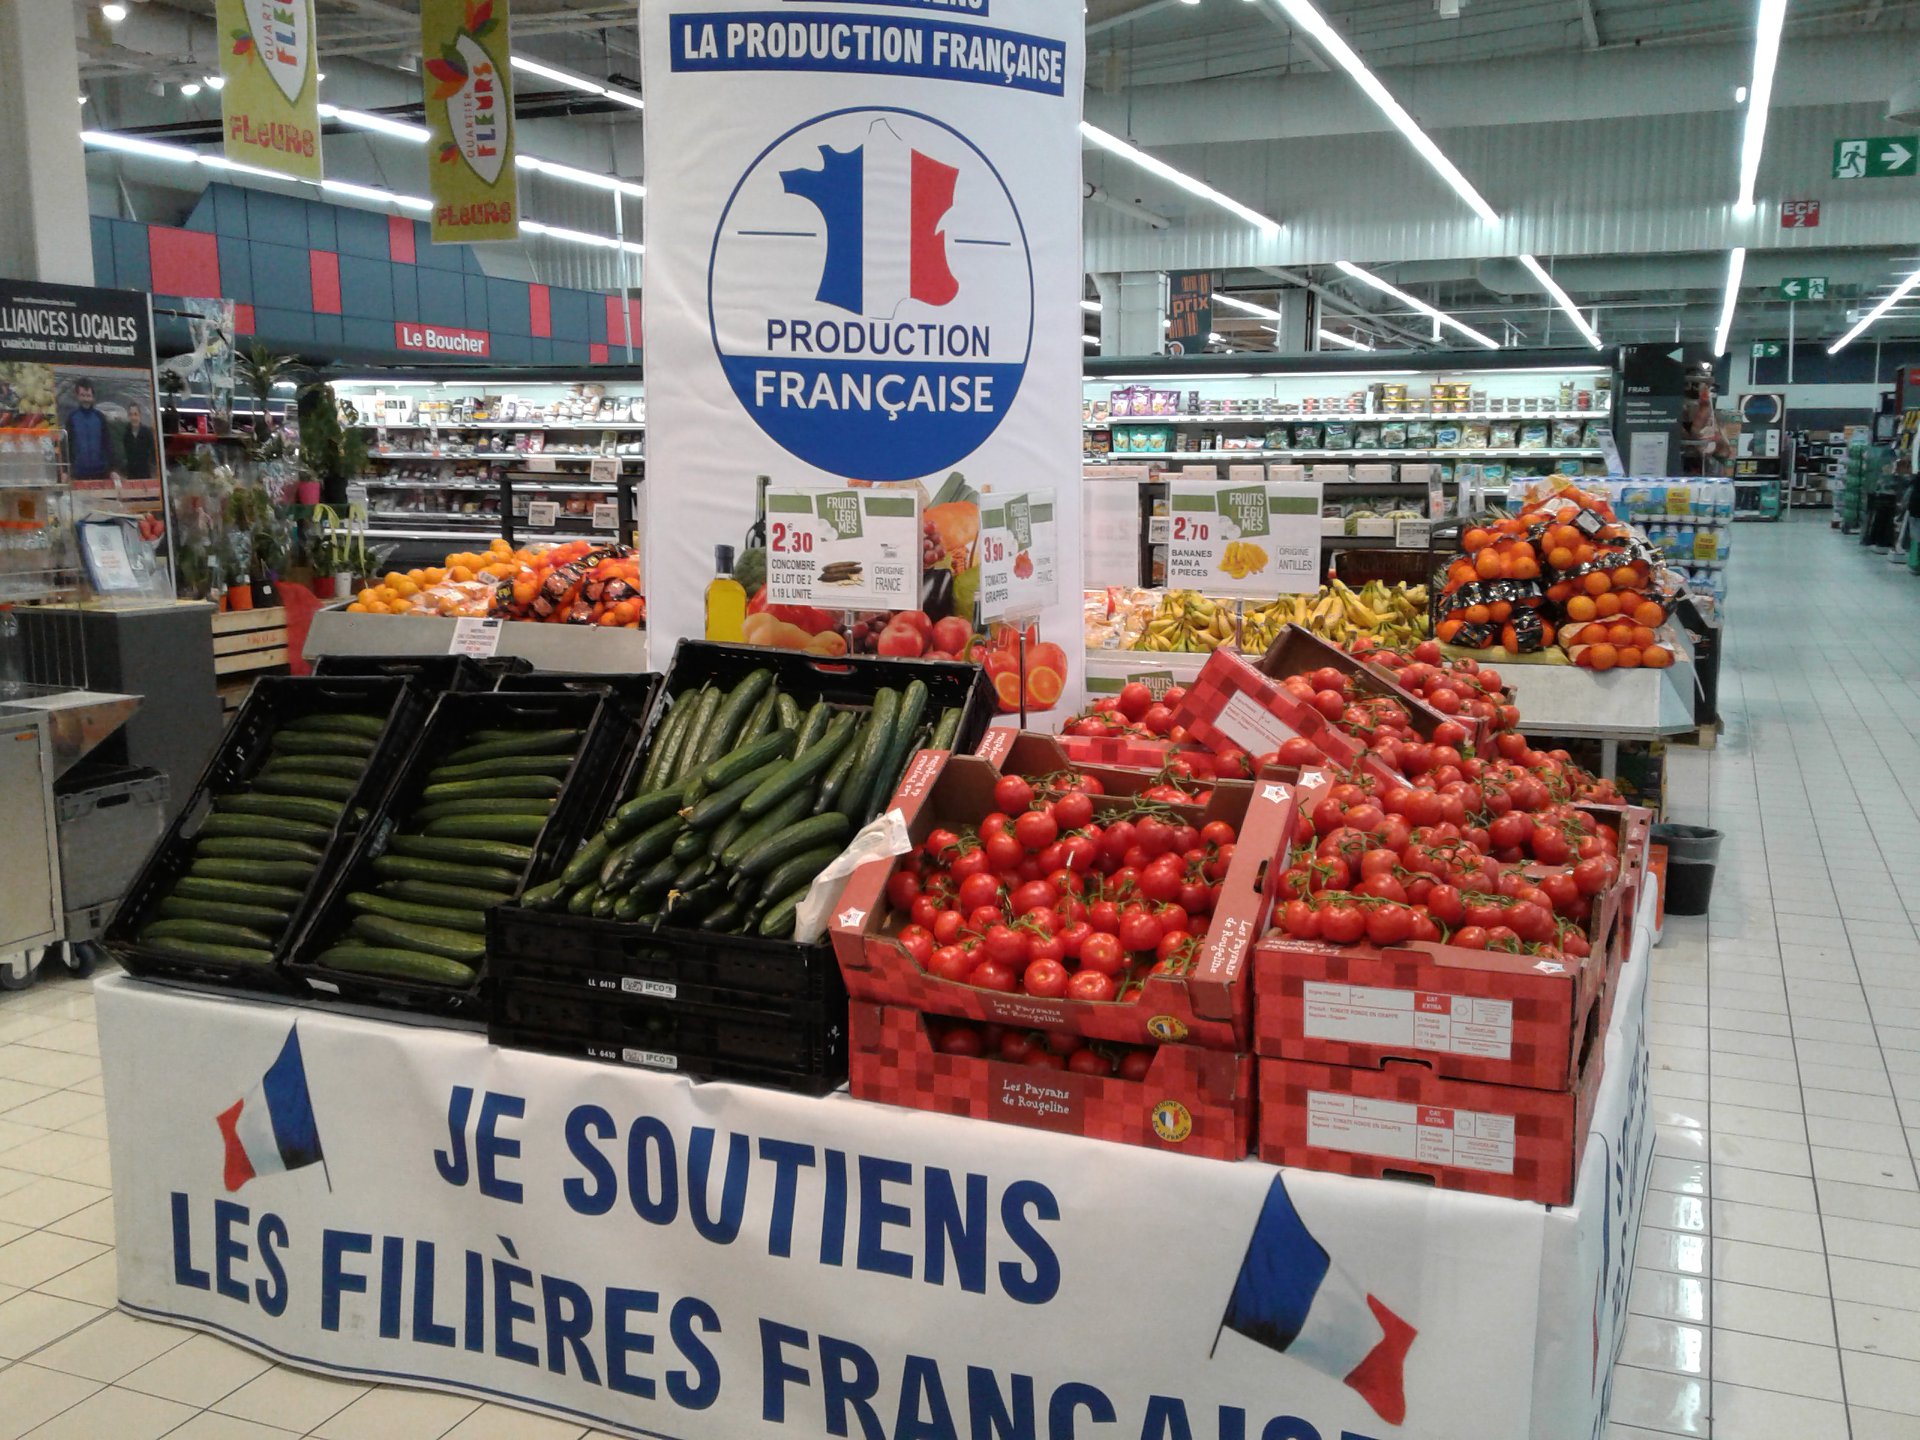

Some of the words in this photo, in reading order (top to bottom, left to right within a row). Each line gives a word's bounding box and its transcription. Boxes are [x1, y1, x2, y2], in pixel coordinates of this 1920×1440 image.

[262, 0, 274, 60] QUART
[273, 0, 298, 66] FLE
[683, 23, 718, 60] LA
[727, 22, 923, 65] PRODUCTION
[932, 31, 1063, 84] FRANÇAISE
[473, 62, 497, 158] FLEURS
[464, 92, 475, 158] QUARTIER
[1783, 201, 1819, 215] ECF
[1794, 214, 1805, 227] 2
[0, 306, 69, 337] LIANCES
[72, 312, 138, 342] LOCALES
[403, 326, 423, 347] Le
[425, 329, 485, 353] Boucher
[767, 318, 990, 358] PRODUCTION
[755, 369, 994, 421] FRANÇAISE
[827, 496, 858, 510] FRUITS
[1229, 492, 1264, 506] FRUITS
[834, 510, 857, 522] LEGU
[1238, 506, 1264, 520] LEGU
[838, 522, 857, 534] MES
[1241, 519, 1264, 531] MES
[1171, 549, 1213, 558] BANANES
[1279, 547, 1310, 557] ORIGINE
[772, 559, 815, 571] CONCOMBRE
[1171, 558, 1192, 568] MAIN
[1193, 559, 1201, 568] A
[1278, 559, 1313, 572] ANTILLES
[875, 566, 904, 576] ORIGINE
[1171, 568, 1176, 577] 6
[1177, 568, 1209, 577] PIECES
[772, 573, 781, 584] LE
[782, 573, 795, 585] LOT
[796, 574, 806, 585] DE
[808, 575, 812, 585] 2
[875, 577, 902, 592] FRANCE
[772, 589, 785, 599] 1.19
[792, 588, 812, 599] UNITE
[1138, 675, 1174, 691] FRUITS
[1239, 920, 1252, 936] Les
[1210, 929, 1234, 974] Rougeline
[1225, 937, 1247, 976] Paysans
[645, 982, 665, 992] IFCO
[600, 1050, 616, 1059] 6410
[646, 1053, 665, 1063] IFCO
[1003, 1080, 1021, 1092] Les
[1024, 1083, 1070, 1100] Paysans
[1003, 1094, 1015, 1105] de
[1018, 1095, 1070, 1116] Rougeline
[433, 1085, 525, 1204] JE
[563, 1103, 1062, 1306] SOUTIENS
[171, 1191, 289, 1318] LES
[321, 1233, 723, 1411] FILIÈRES
